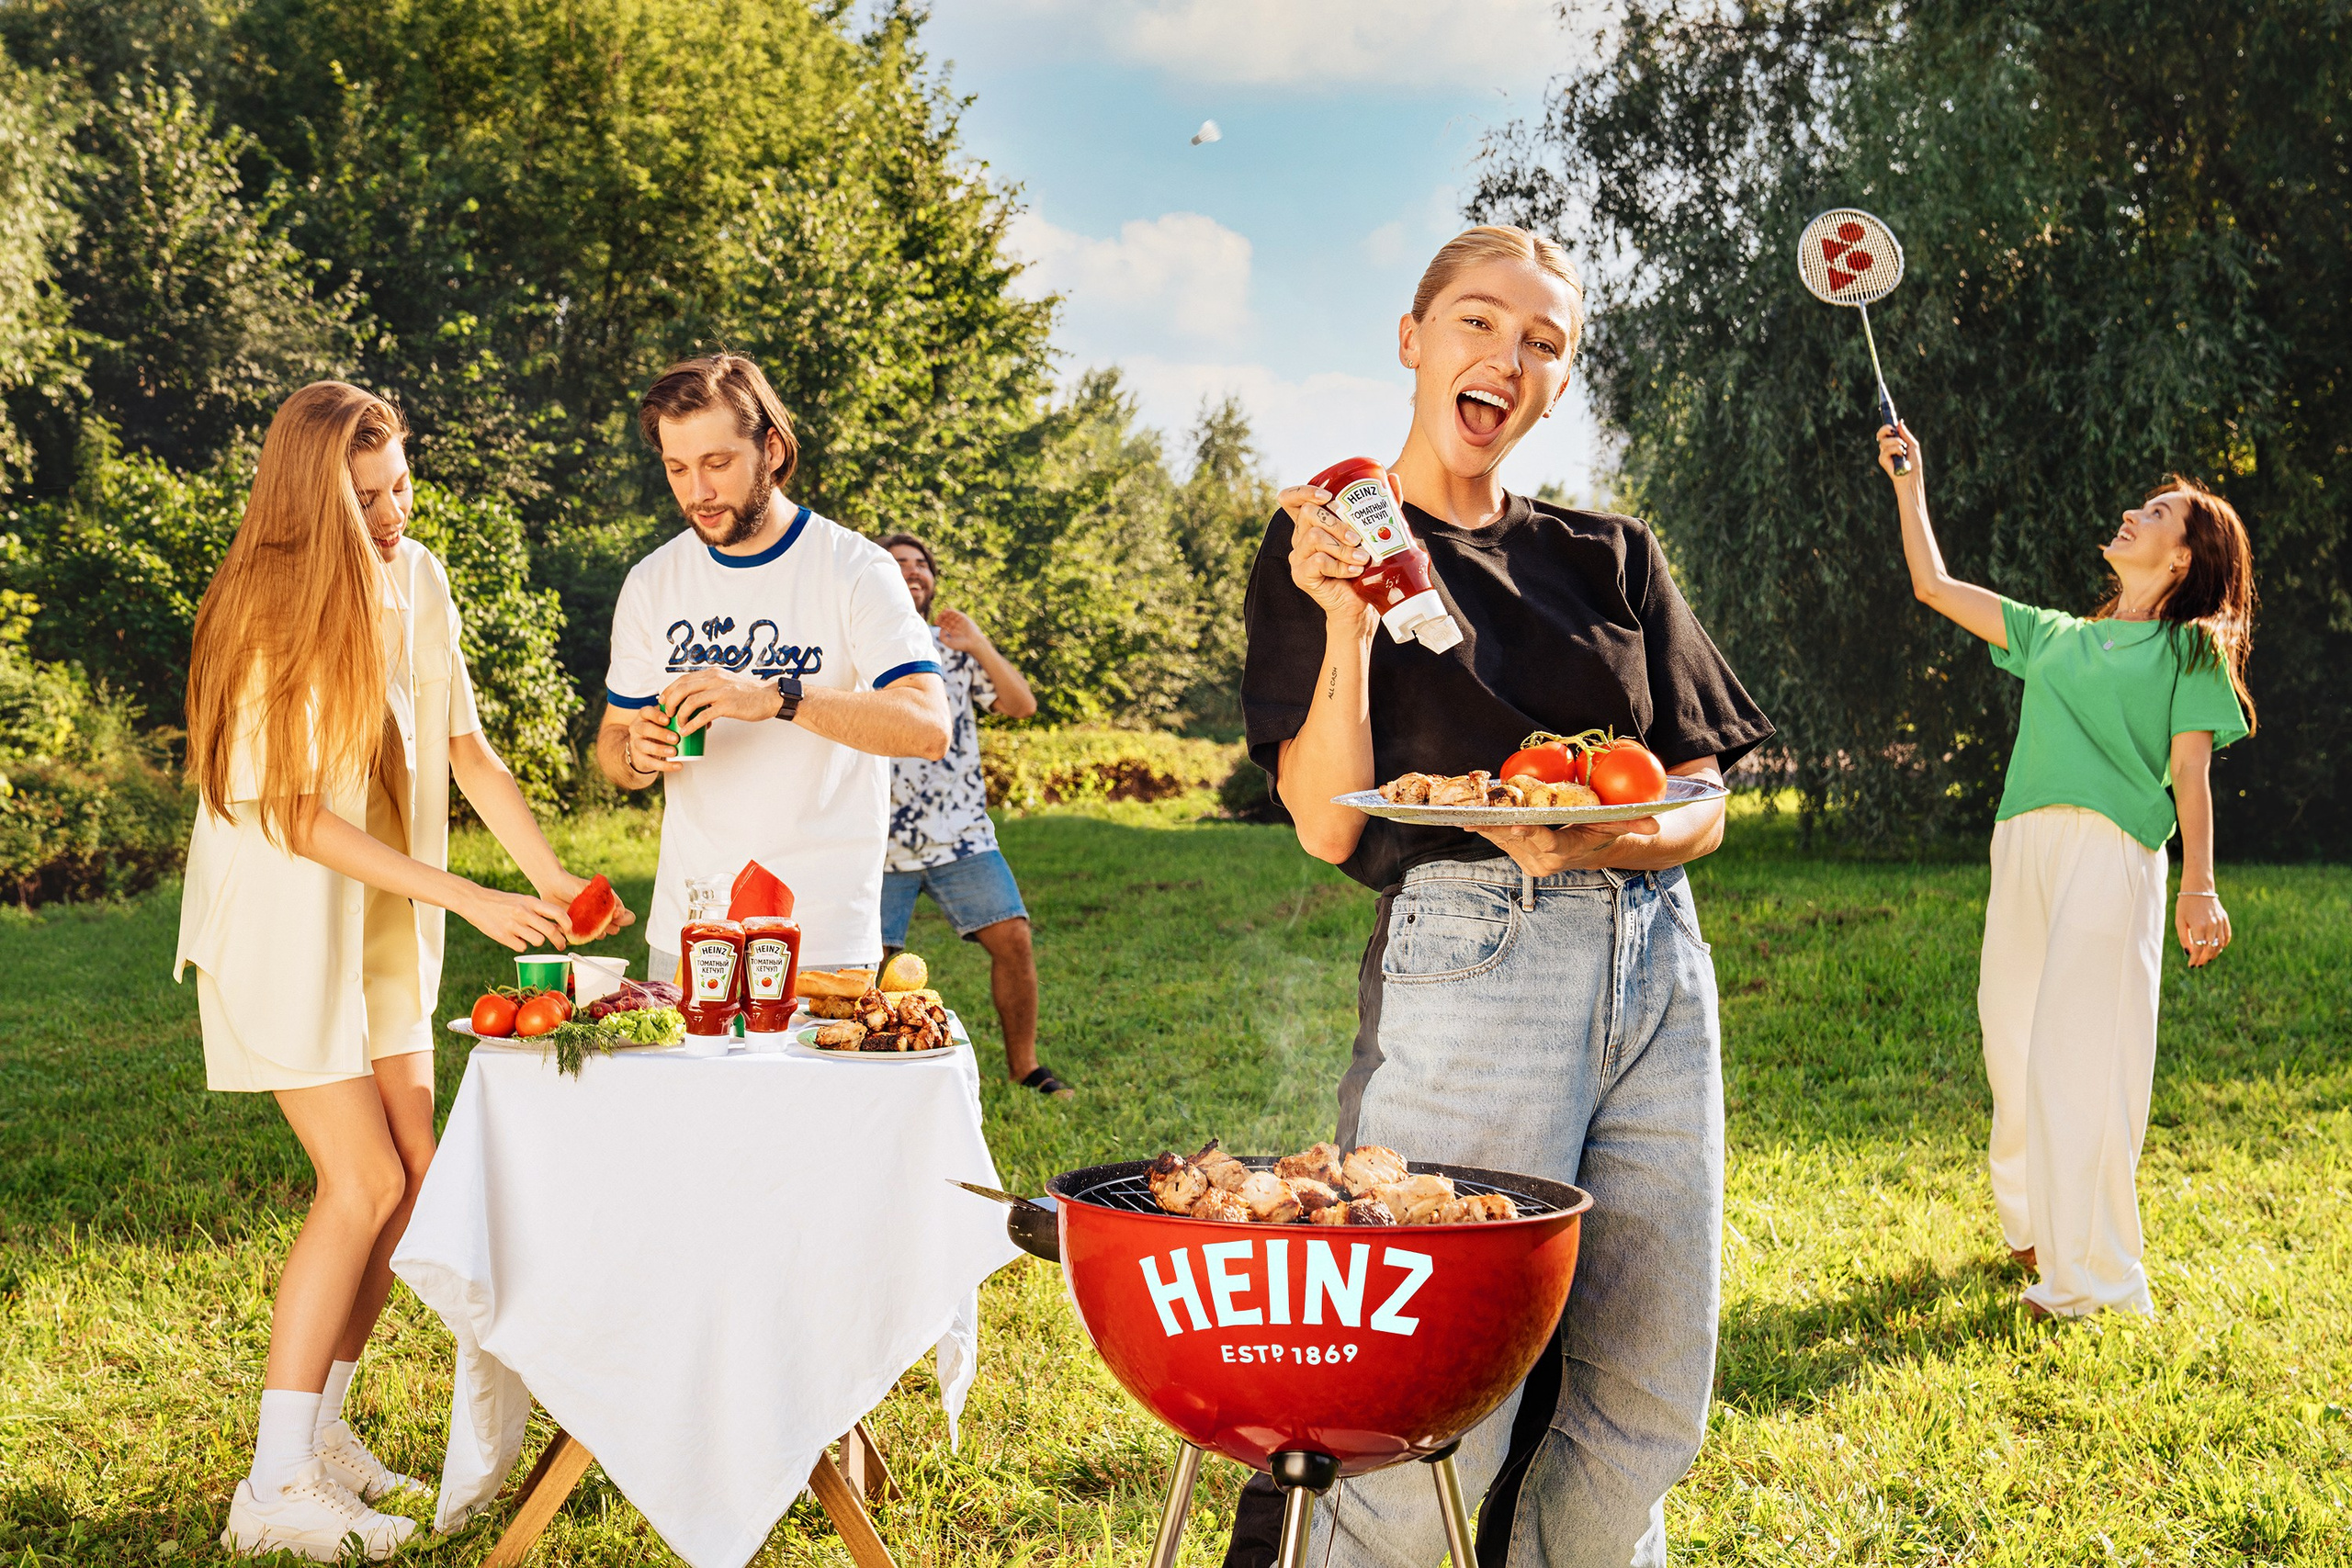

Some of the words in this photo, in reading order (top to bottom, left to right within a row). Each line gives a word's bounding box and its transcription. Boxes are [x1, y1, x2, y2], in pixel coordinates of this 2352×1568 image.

[1347, 486, 1377, 504] HEINZ
[1350, 498, 1388, 521] ТОМАТНЫЙ
[1361, 510, 1388, 526] КЕТЧУП
[701, 615, 735, 641] The
[665, 619, 753, 672] Beach
[749, 618, 822, 680] Boys
[702, 945, 727, 956] HEINZ
[755, 944, 781, 954] HEINZ
[696, 959, 729, 967] ТОМАТНЫЙ
[751, 957, 783, 966] ТОМАТНЫЙ
[755, 964, 779, 973] КЕТЧУП
[1139, 1239, 1433, 1337] HEINZ
[1291, 1344, 1358, 1365] 1869
